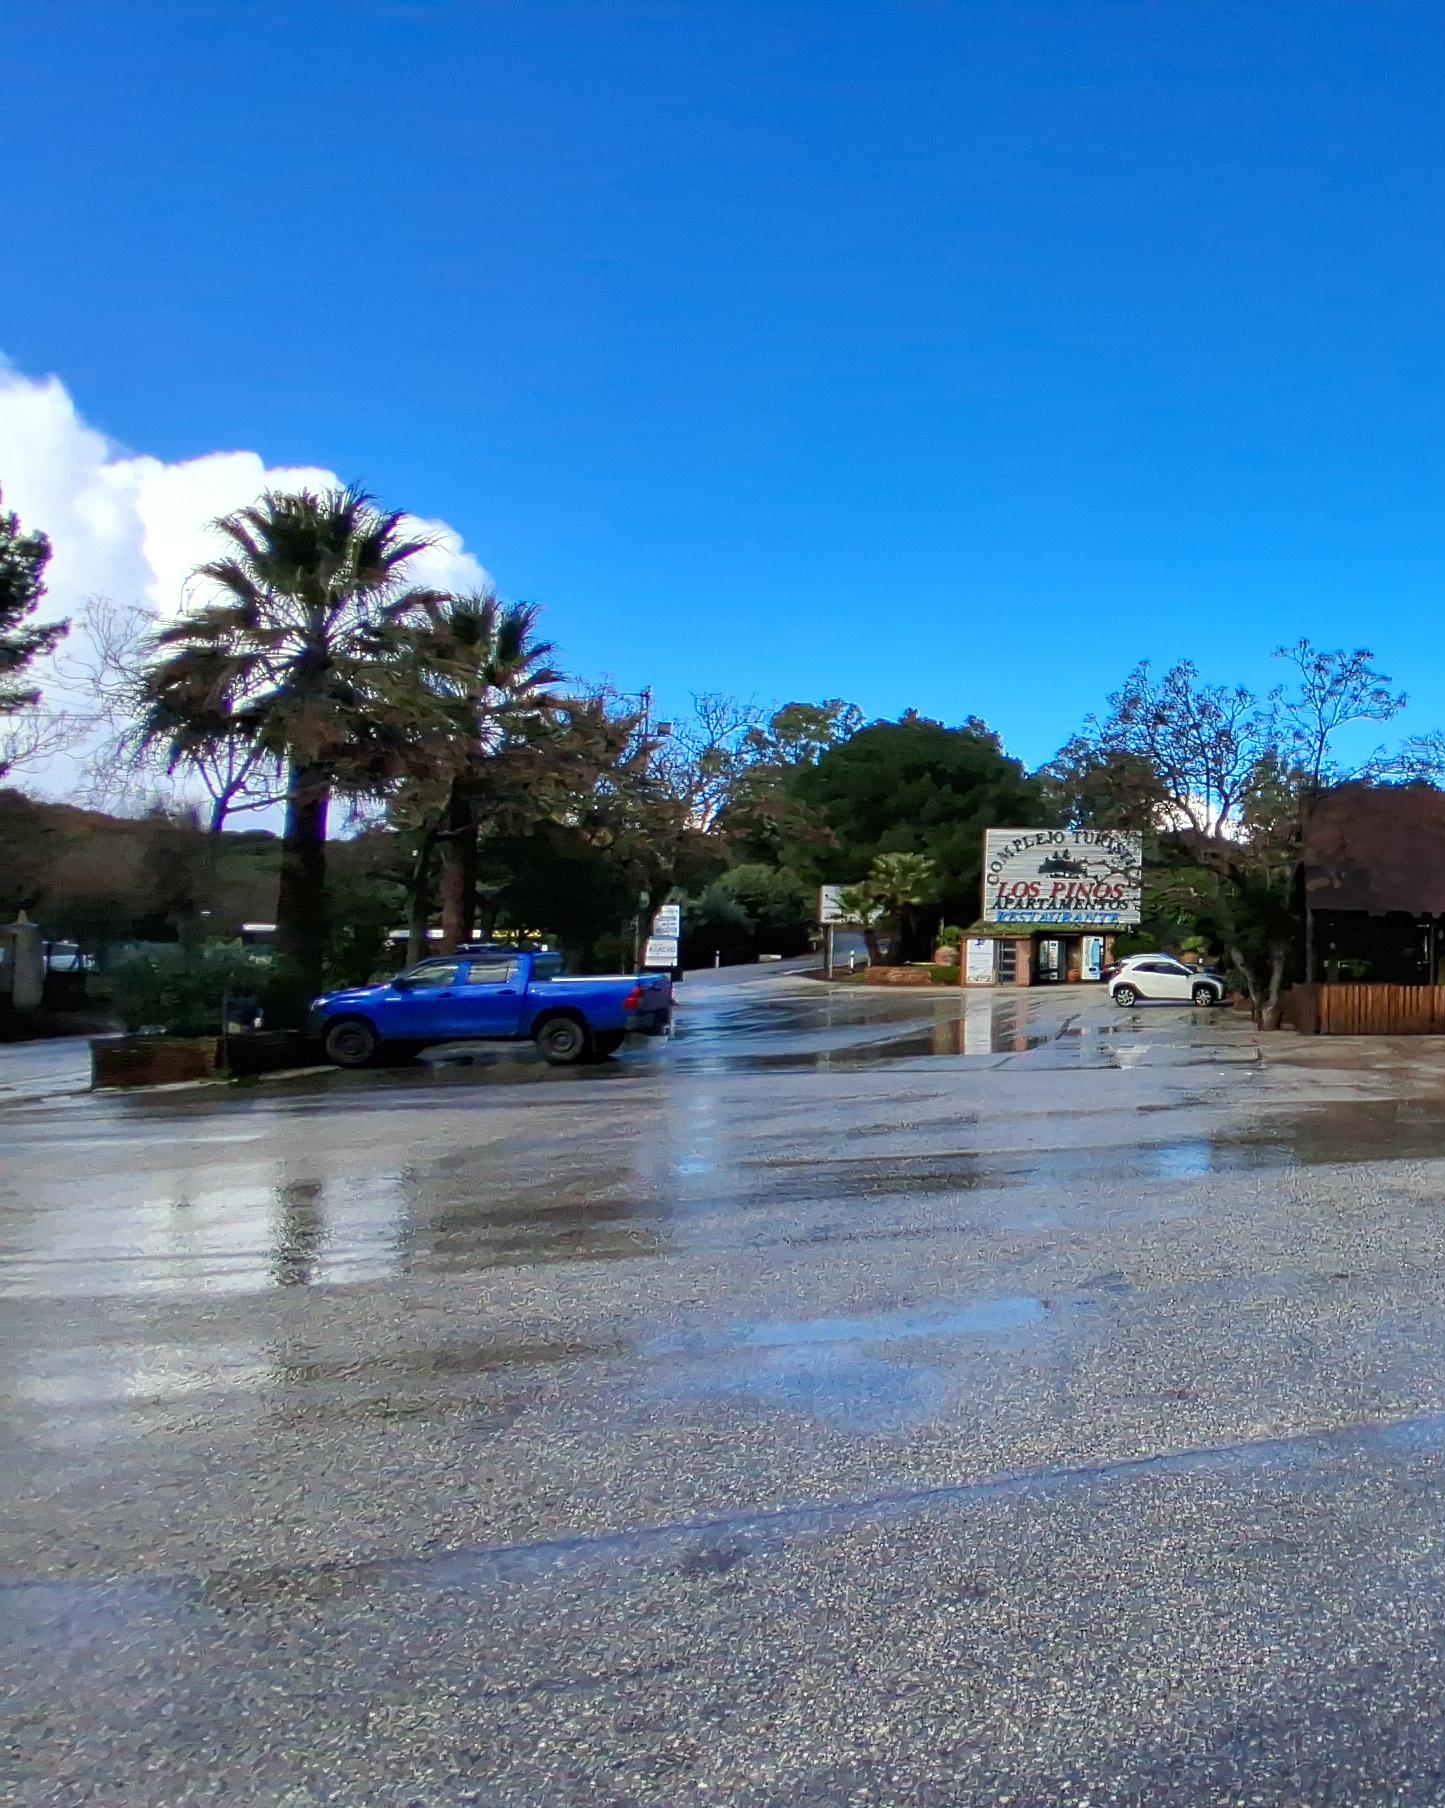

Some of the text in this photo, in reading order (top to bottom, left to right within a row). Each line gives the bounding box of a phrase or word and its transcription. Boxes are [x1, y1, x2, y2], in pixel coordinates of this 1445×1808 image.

[987, 831, 1065, 886] COMPLEJO
[997, 881, 1125, 900] LOS PINOS
[990, 895, 1128, 911] APARTAMENTOS
[996, 911, 1120, 923] RESTAURANTE
